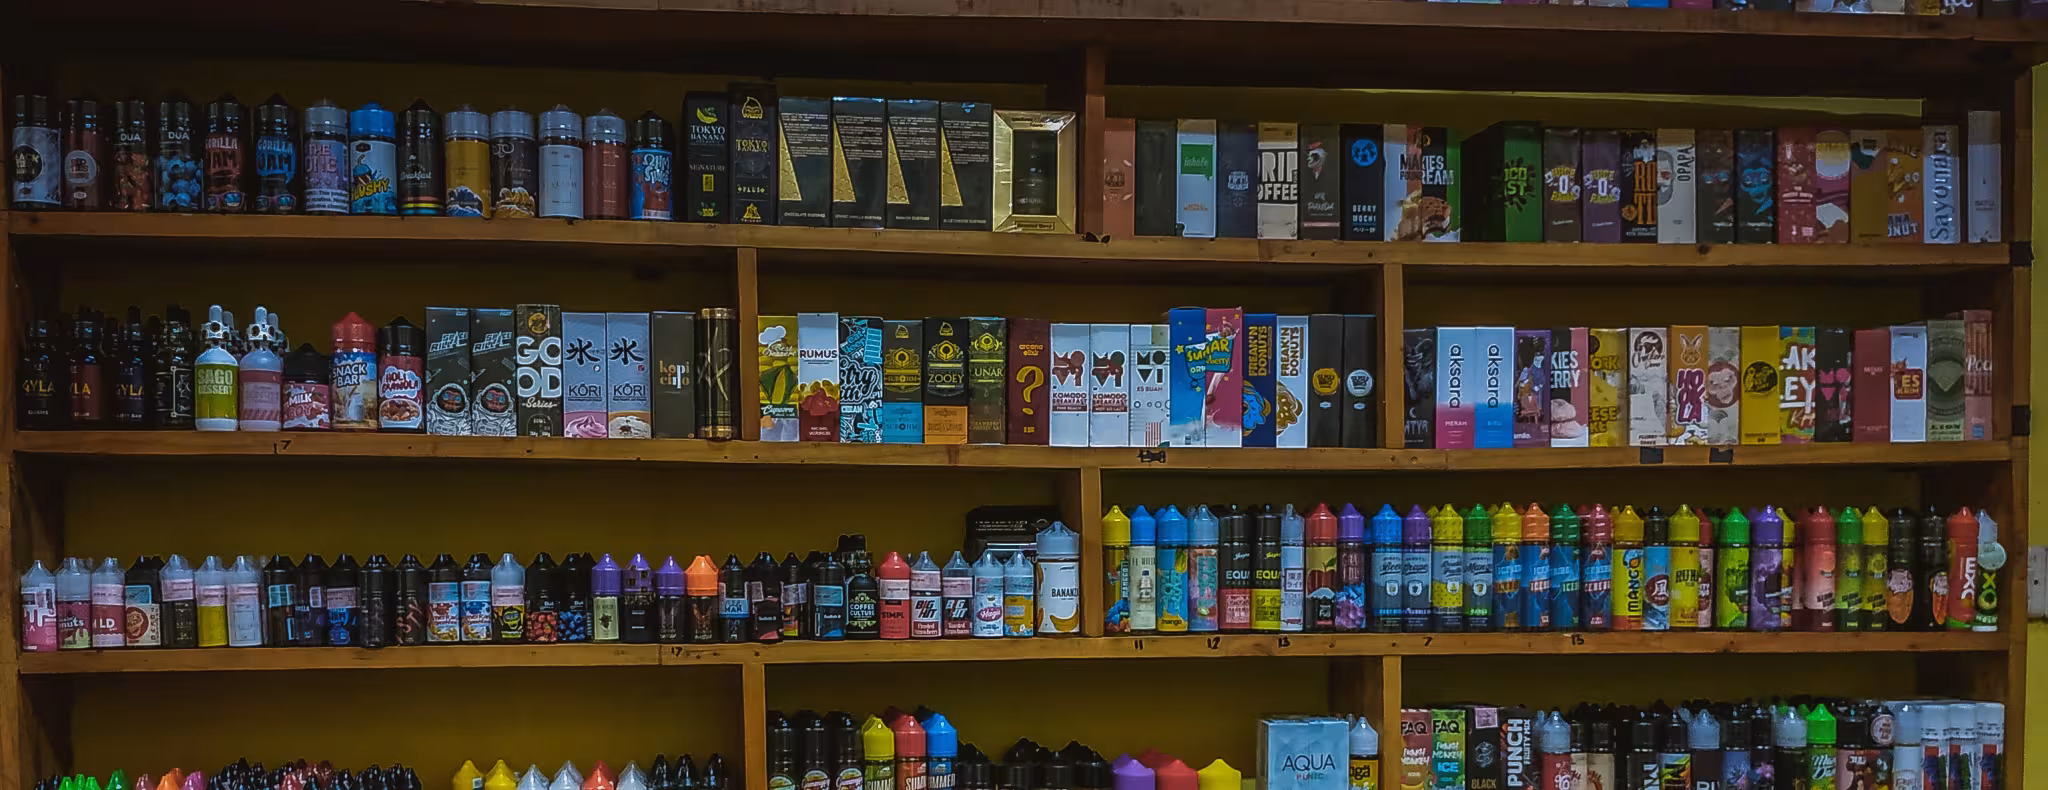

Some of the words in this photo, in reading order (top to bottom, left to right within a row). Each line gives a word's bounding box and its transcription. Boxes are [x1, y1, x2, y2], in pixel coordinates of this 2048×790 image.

[168, 131, 190, 141] DUA
[690, 124, 725, 135] TOKYO
[120, 133, 142, 142] DUA
[690, 133, 725, 142] BANANA
[1930, 129, 1954, 241] Sayonara
[799, 348, 839, 359] RUMUS
[1248, 325, 1258, 377] FREAK'N
[1257, 325, 1268, 377] DONUTS
[1280, 326, 1290, 377] FREAK'N
[1289, 326, 1300, 377] DONUTS
[197, 368, 233, 386] SAGO
[332, 362, 367, 380] SNACK
[928, 373, 965, 384] ZOOEY
[1449, 344, 1465, 409] aksara
[1487, 344, 1503, 409] aksara
[337, 375, 360, 388] BAR
[289, 393, 313, 406] MILK
[1052, 392, 1088, 400] KOMODO
[1052, 399, 1088, 407] BREAKFAST
[1092, 399, 1128, 407] BREAKFAST
[1401, 721, 1428, 735] FAQ
[1432, 719, 1460, 734] FAQ
[1523, 718, 1531, 736] MIX
[1432, 749, 1462, 760] MONKEY
[1507, 718, 1524, 787] PUNCH
[1523, 737, 1531, 765] FRUITY
[1281, 754, 1336, 772] AQUA
